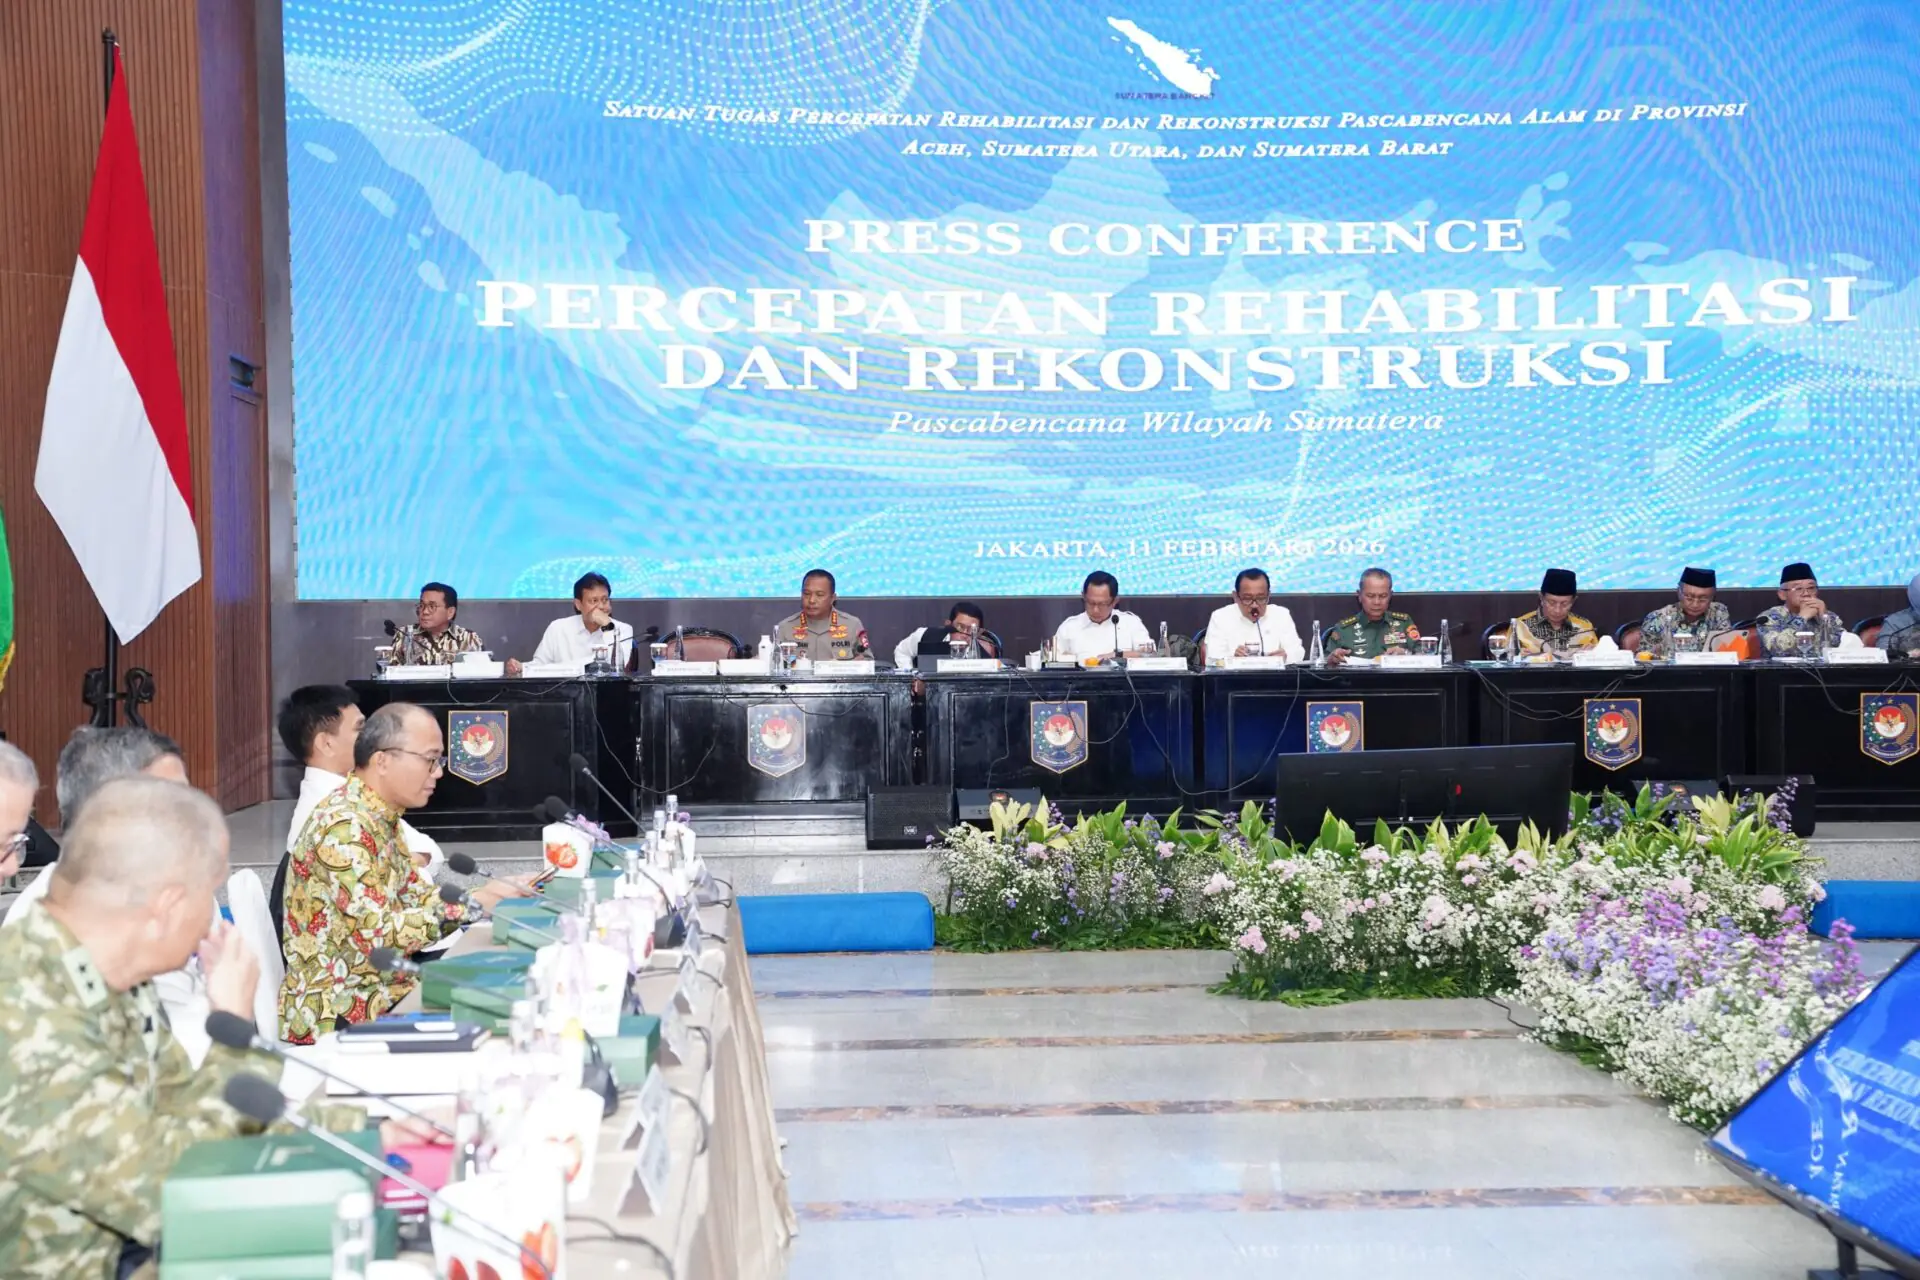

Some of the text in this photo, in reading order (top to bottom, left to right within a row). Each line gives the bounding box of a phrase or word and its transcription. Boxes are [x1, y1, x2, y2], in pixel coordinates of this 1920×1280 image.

[602, 101, 695, 121] SATUAN
[703, 104, 780, 124] TUGAS
[788, 107, 931, 126] PERCEPATAN
[938, 111, 1095, 129] REHABILITASI
[1156, 113, 1331, 130] REKONSTRUKSI
[1337, 112, 1512, 128] PASCABENCANA
[1519, 108, 1586, 124] ALAM
[1629, 103, 1747, 121] PROVINSI
[901, 140, 971, 159] ACEH,
[982, 141, 1098, 158] SUMATERA
[1110, 142, 1187, 160] UTARA,
[1253, 141, 1370, 158] SUMATERA
[1379, 140, 1453, 157] BARAT
[803, 218, 1524, 258] PRESS CONFERENCE
[476, 275, 1858, 337] PERCEPATAN REHABILITASI
[659, 339, 1674, 393] DAN REKONSTRUKSI
[888, 409, 1444, 438] Pascabencana Wilayah Sumatera
[973, 538, 1386, 559] JAKARTA, 11 FEBRUARI 2026
